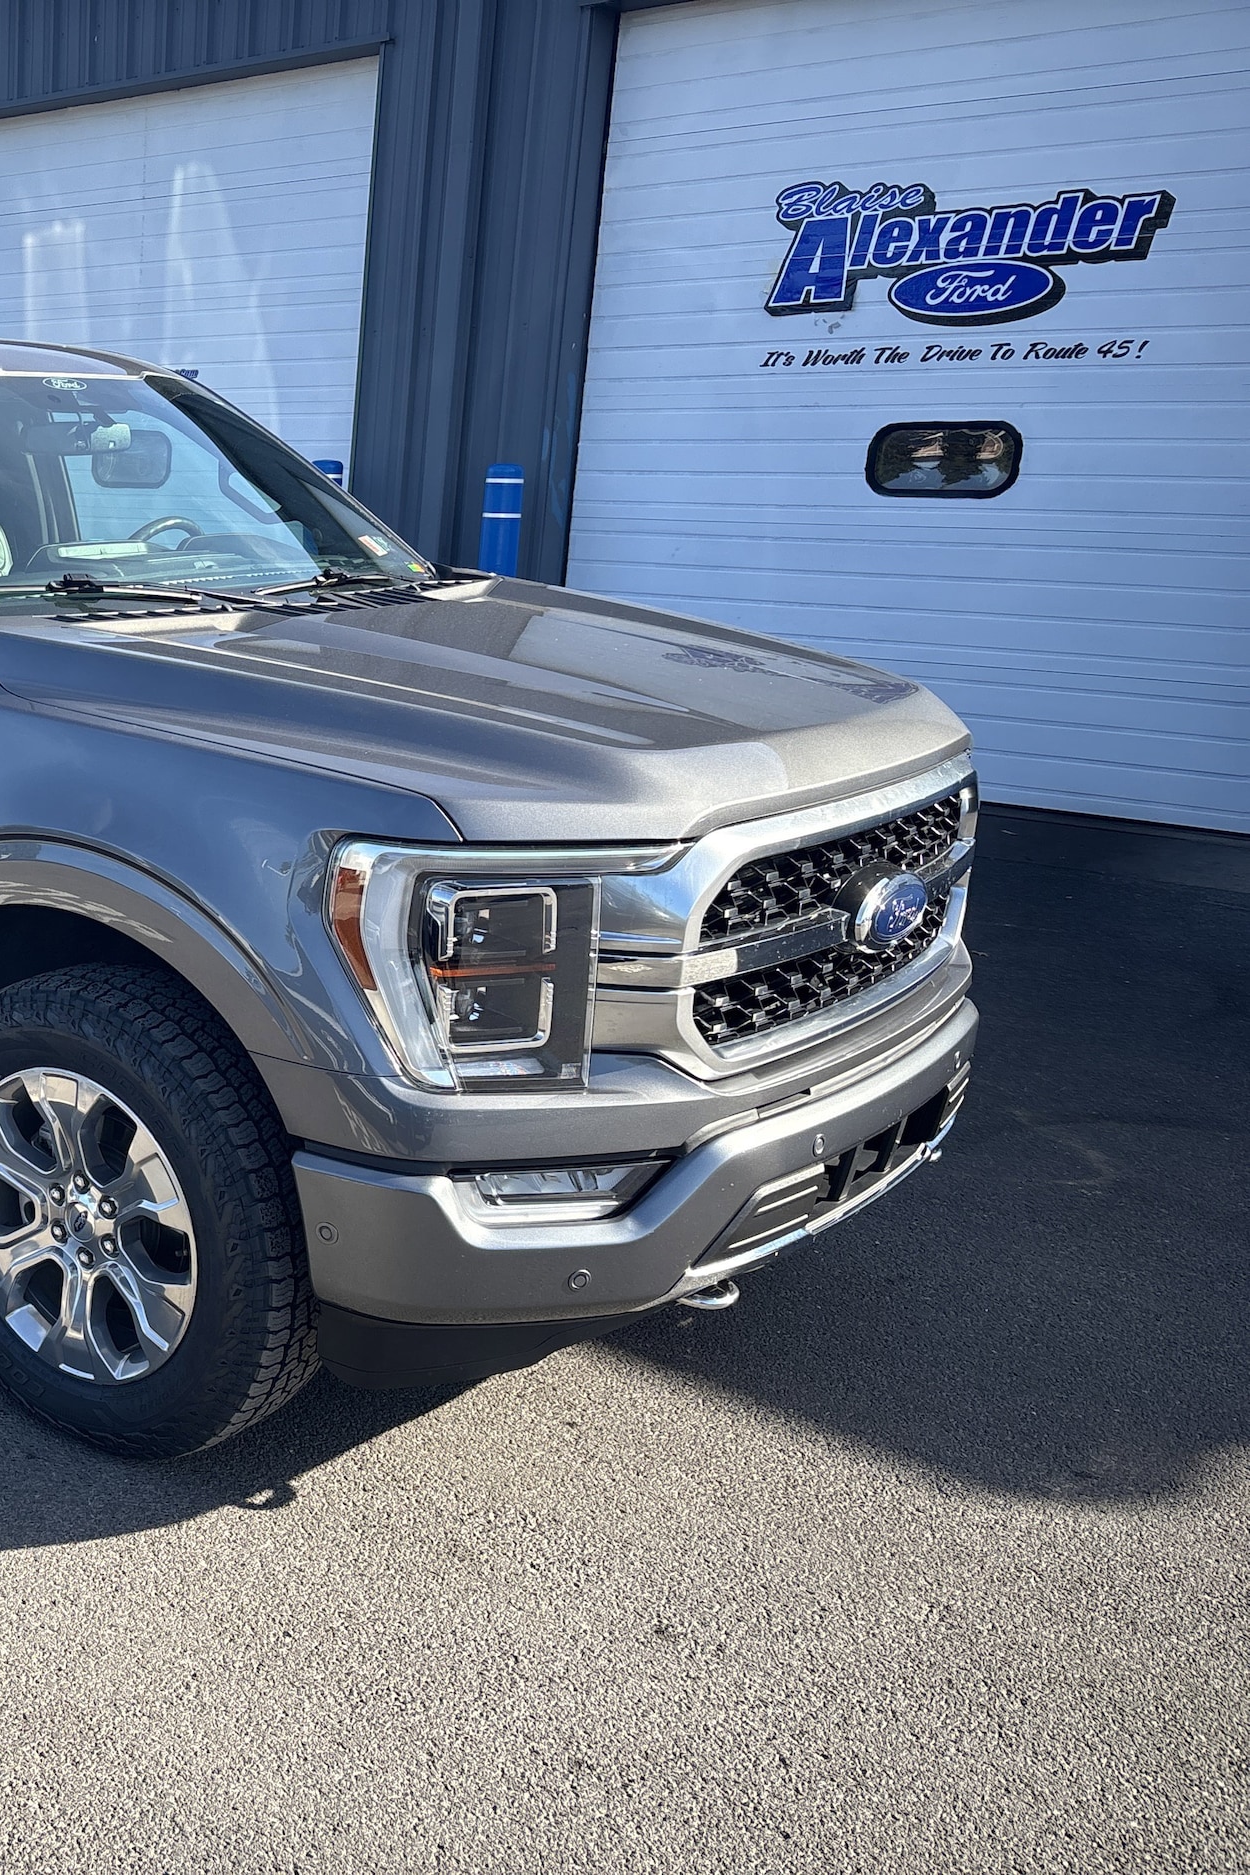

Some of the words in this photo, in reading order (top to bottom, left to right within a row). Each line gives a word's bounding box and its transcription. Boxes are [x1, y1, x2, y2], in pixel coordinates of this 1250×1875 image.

[777, 184, 926, 221] Blaise
[767, 190, 1164, 307] Alexander
[926, 269, 1013, 305] Ford
[759, 350, 796, 368] It's
[801, 346, 867, 367] Worth
[873, 345, 911, 365] The
[919, 343, 983, 363] Drive
[990, 342, 1016, 361] To
[1022, 341, 1090, 361] Route
